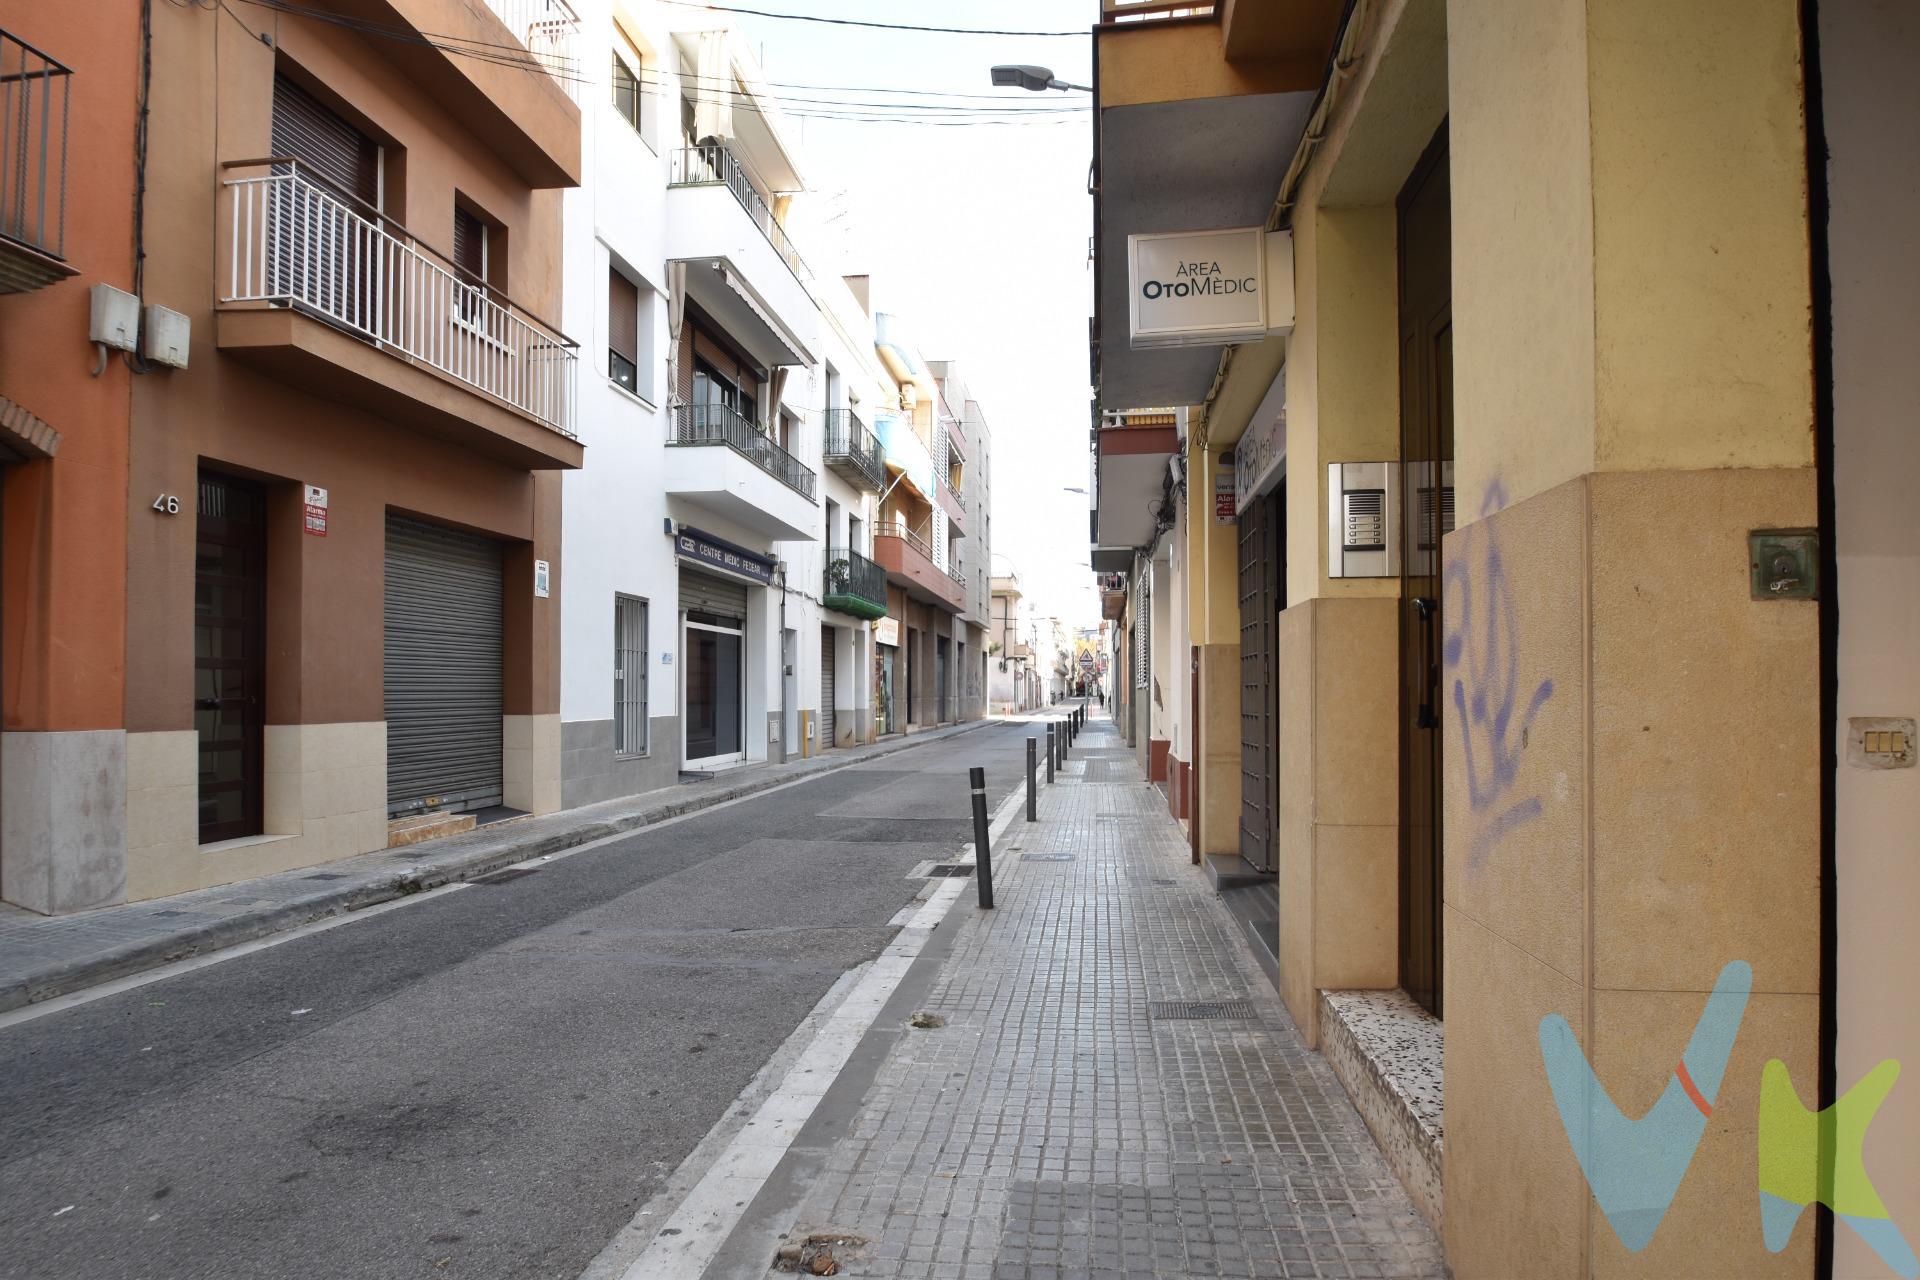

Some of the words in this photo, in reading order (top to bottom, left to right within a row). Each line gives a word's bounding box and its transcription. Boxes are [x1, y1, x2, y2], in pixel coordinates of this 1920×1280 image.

[1176, 261, 1222, 278] ÀREA
[153, 493, 179, 514] 46
[306, 505, 326, 516] Alarma
[699, 543, 722, 561] CENTRE
